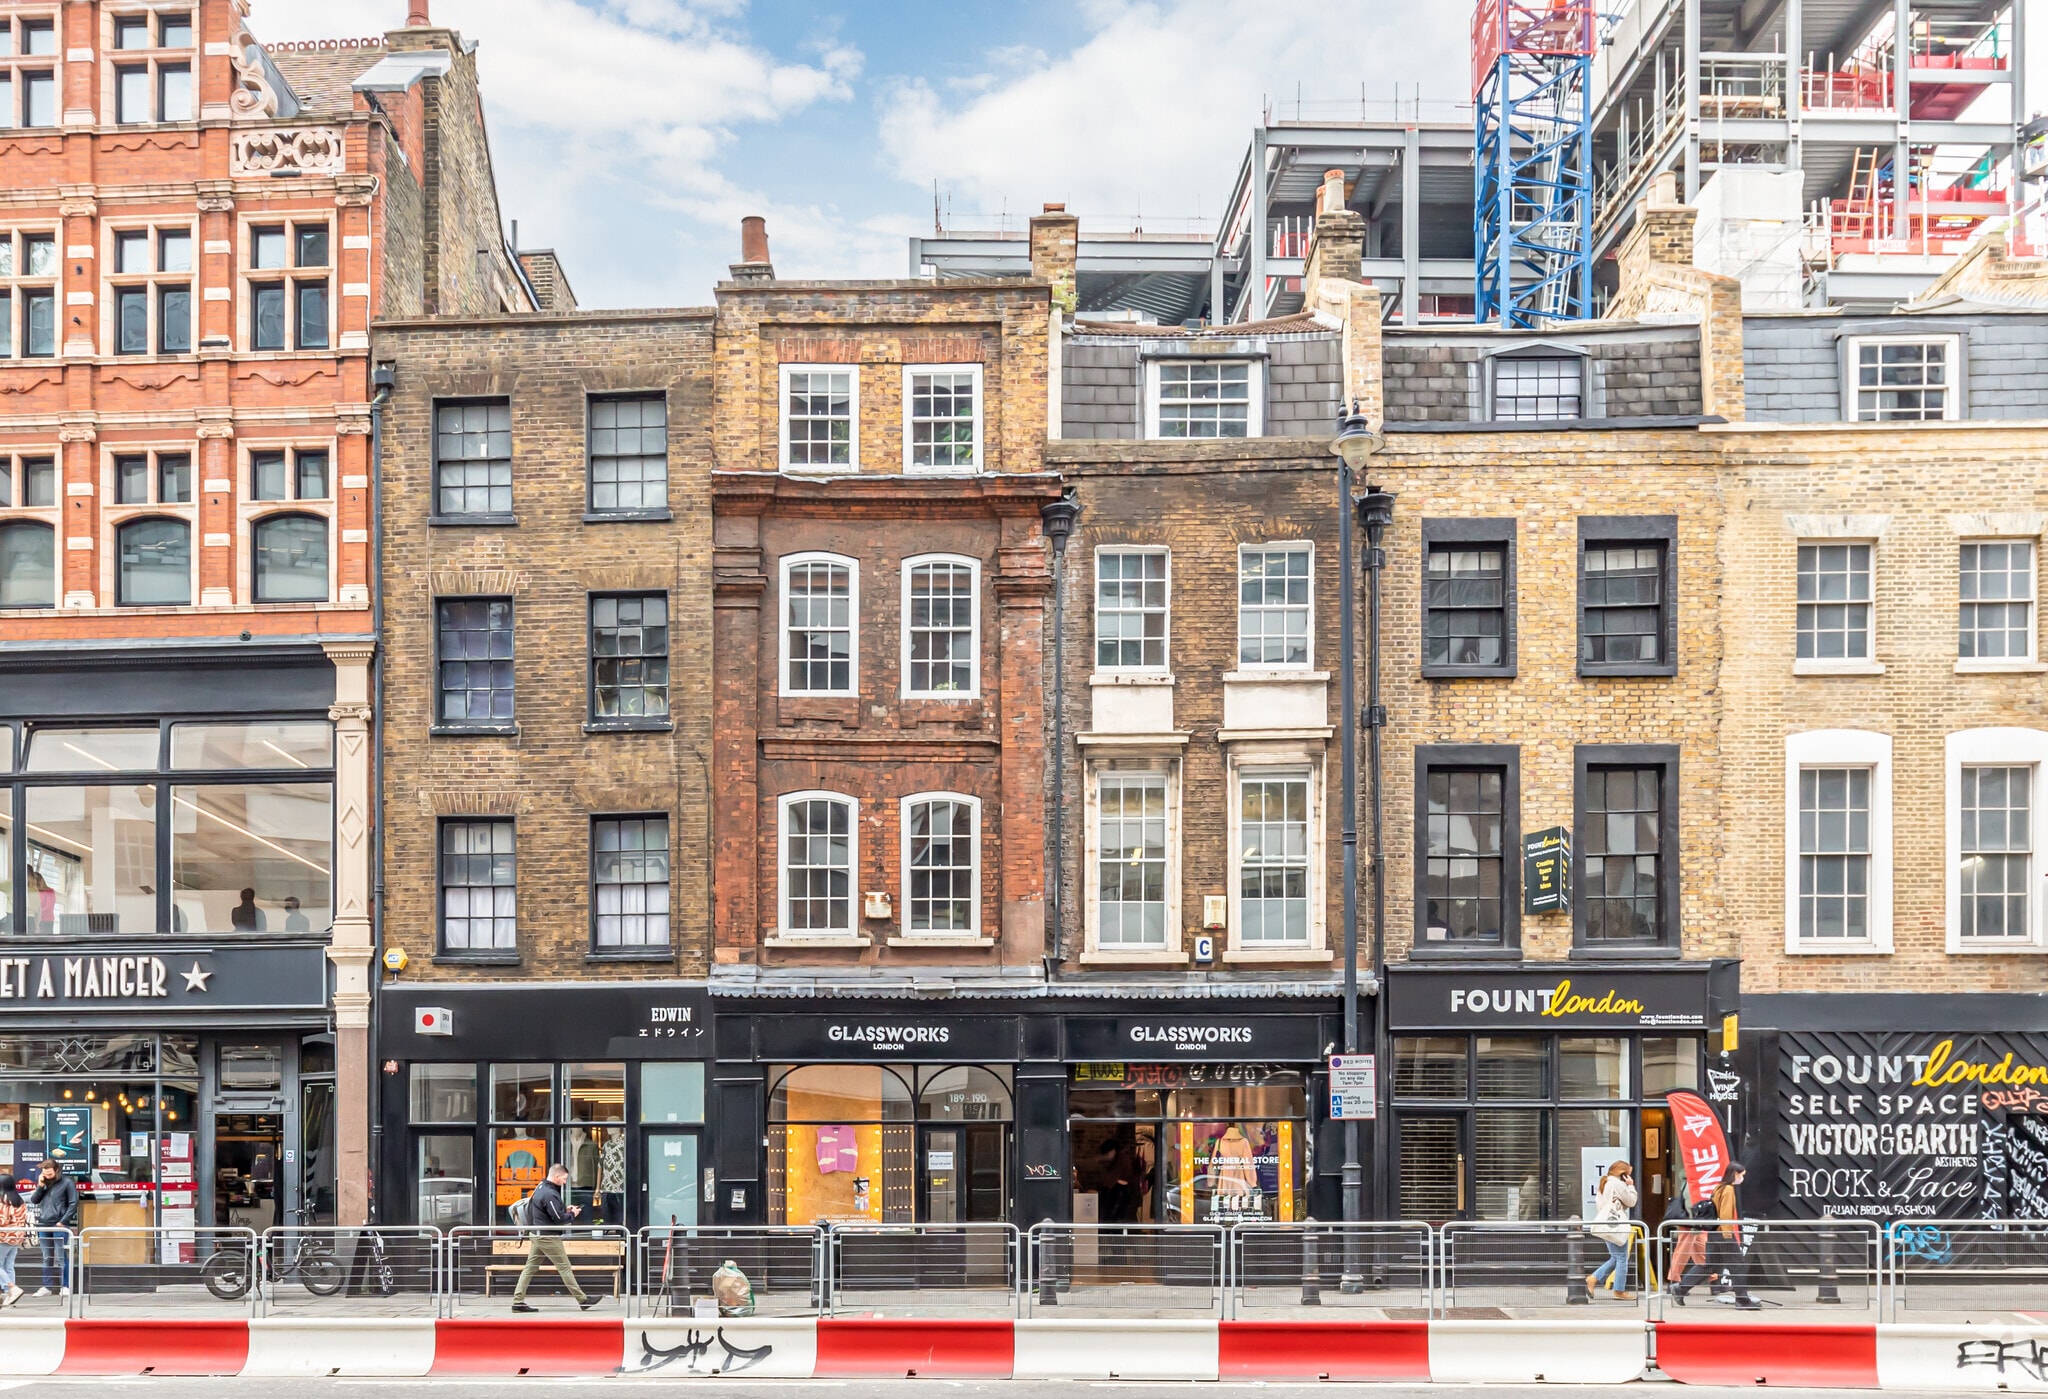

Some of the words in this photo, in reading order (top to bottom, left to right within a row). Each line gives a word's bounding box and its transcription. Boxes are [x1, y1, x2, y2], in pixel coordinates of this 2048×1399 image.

[1199, 940, 1210, 956] C
[37, 958, 55, 998] A
[64, 957, 168, 998] MANGER
[1451, 990, 1556, 1012] FOUNT
[1541, 979, 1644, 1017] london
[651, 1007, 691, 1021] EDWIN
[639, 1028, 704, 1037] エドウイン
[828, 1025, 950, 1043] GLASSWORKS
[1130, 1026, 1252, 1042] GLASSWORKS
[1792, 1055, 1931, 1084] FOUNT
[1715, 1083, 1735, 1091] WINE
[950, 1094, 964, 1102] 189
[972, 1094, 986, 1102] 190
[1710, 1092, 1738, 1100] HOUSE
[1789, 1095, 1863, 1116] SELF
[1878, 1094, 1977, 1115] SPACE
[1253, 1156, 1279, 1164] STORE
[1935, 1157, 1977, 1167] AESTHETICS
[1789, 1168, 1875, 1197] ROCK
[1878, 1181, 1891, 1198] &
[1892, 1167, 1977, 1203] Lace
[1823, 1204, 1858, 1215] ITALIAN
[1860, 1204, 1893, 1215] BRIDAL
[1894, 1204, 1936, 1215] FASHION
